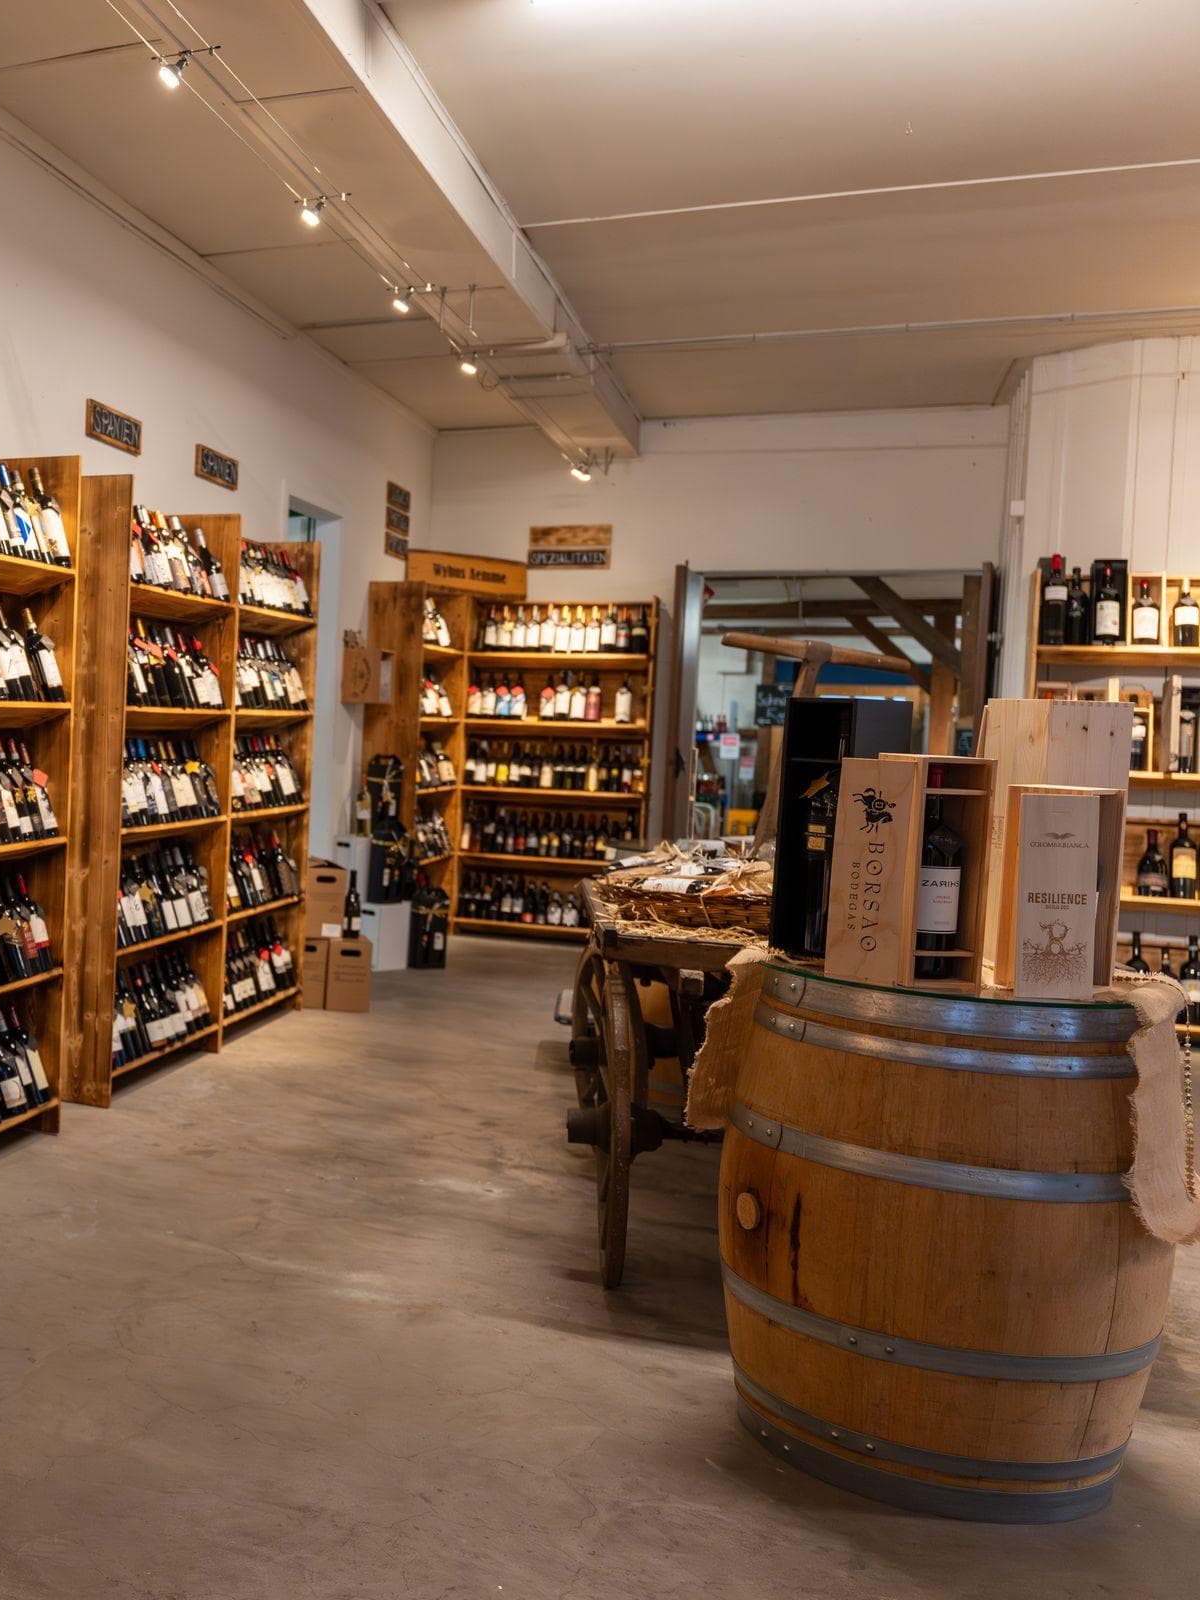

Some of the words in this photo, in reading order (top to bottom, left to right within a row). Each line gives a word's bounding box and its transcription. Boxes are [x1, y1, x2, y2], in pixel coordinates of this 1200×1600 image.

[94, 406, 141, 447] SPANIEN
[847, 862, 861, 931] BODEGAS
[860, 842, 885, 952] BORSAO
[1027, 891, 1088, 905] RESILIENCE
